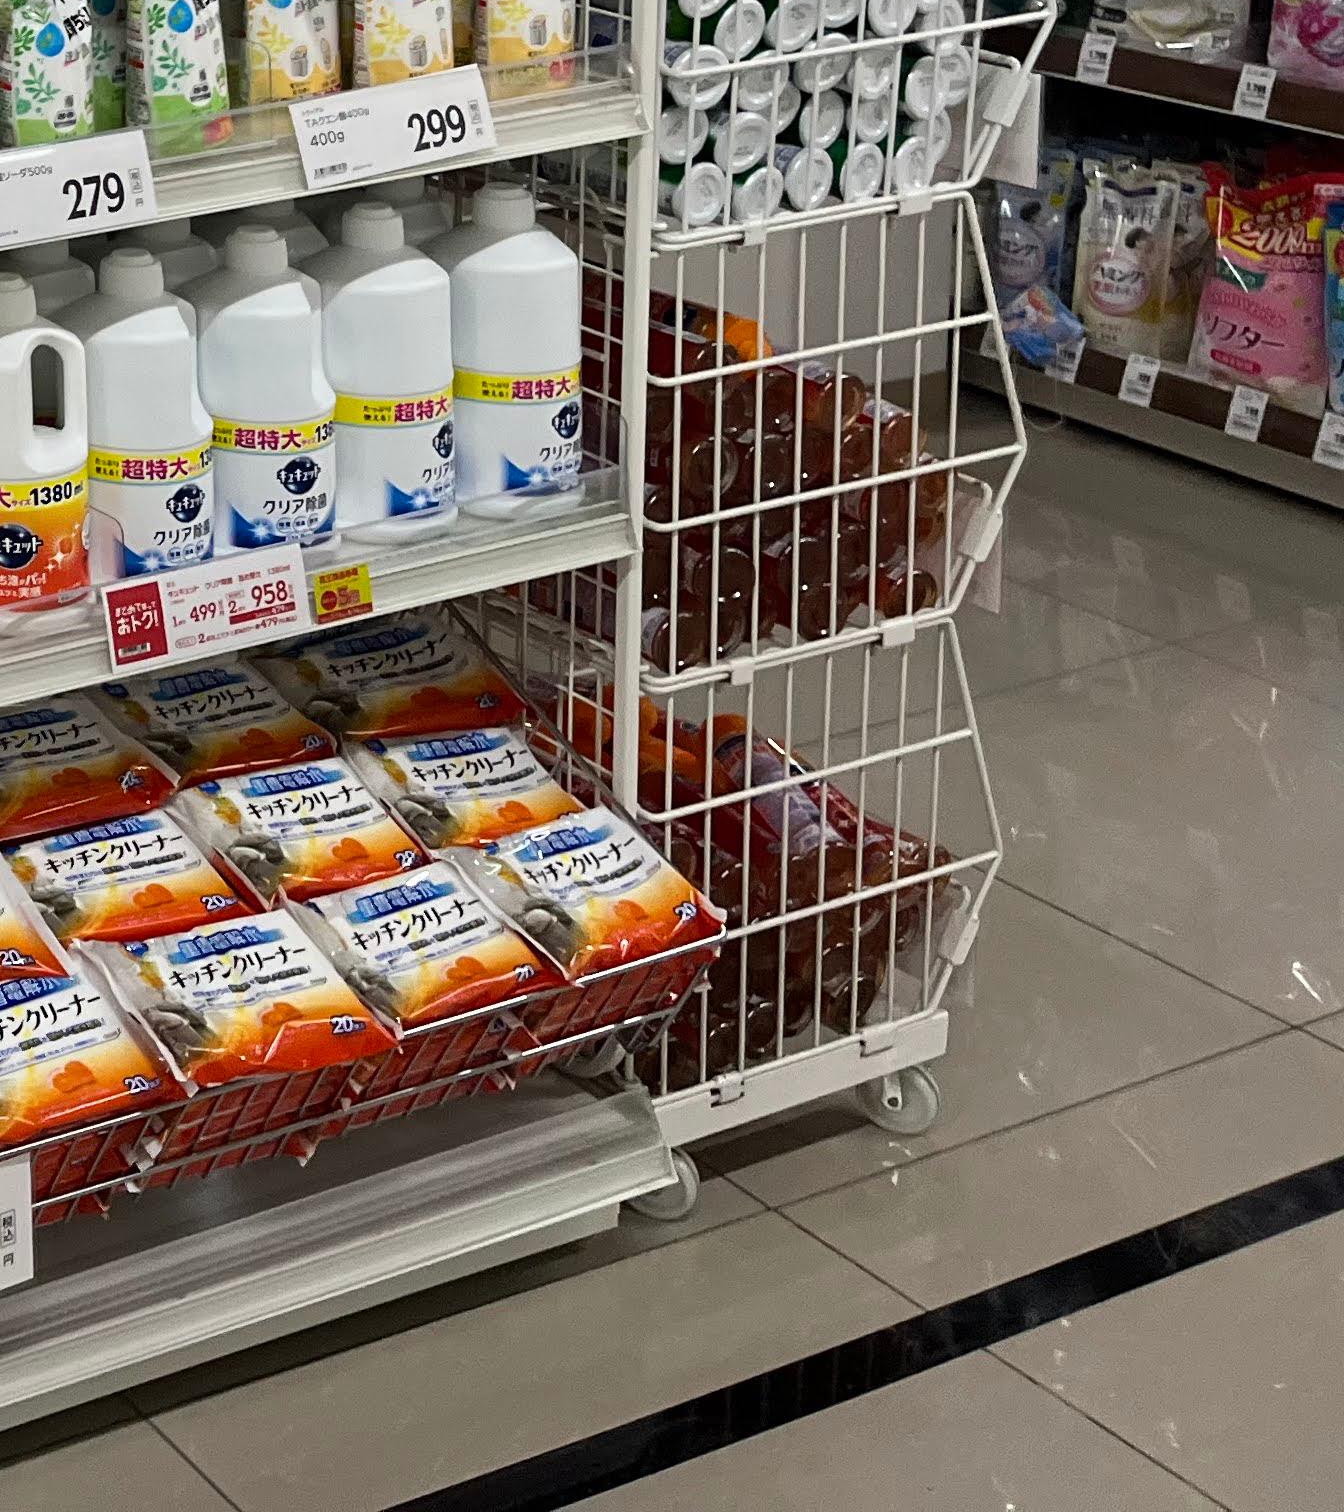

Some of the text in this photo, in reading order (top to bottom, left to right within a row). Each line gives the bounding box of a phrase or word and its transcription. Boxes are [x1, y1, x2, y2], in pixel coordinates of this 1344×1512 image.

[309, 104, 467, 154] 400g 299
[61, 170, 127, 222] 279
[509, 375, 573, 401] 超特大
[233, 425, 302, 452] 超特大
[120, 455, 190, 482] 超特大
[30, 480, 74, 507] 1380
[261, 496, 329, 516] クリア除菌
[189, 602, 217, 623] 499
[250, 579, 289, 608] 958
[408, 744, 529, 785] キッチンクリーナー
[243, 781, 366, 821] キッチンクリーナー
[44, 830, 184, 875] キッチンクリーナー
[521, 833, 635, 887] キッチンクリーナー
[349, 895, 481, 955] キッチンクリーナー
[166, 942, 308, 994] キッチンクリーナー
